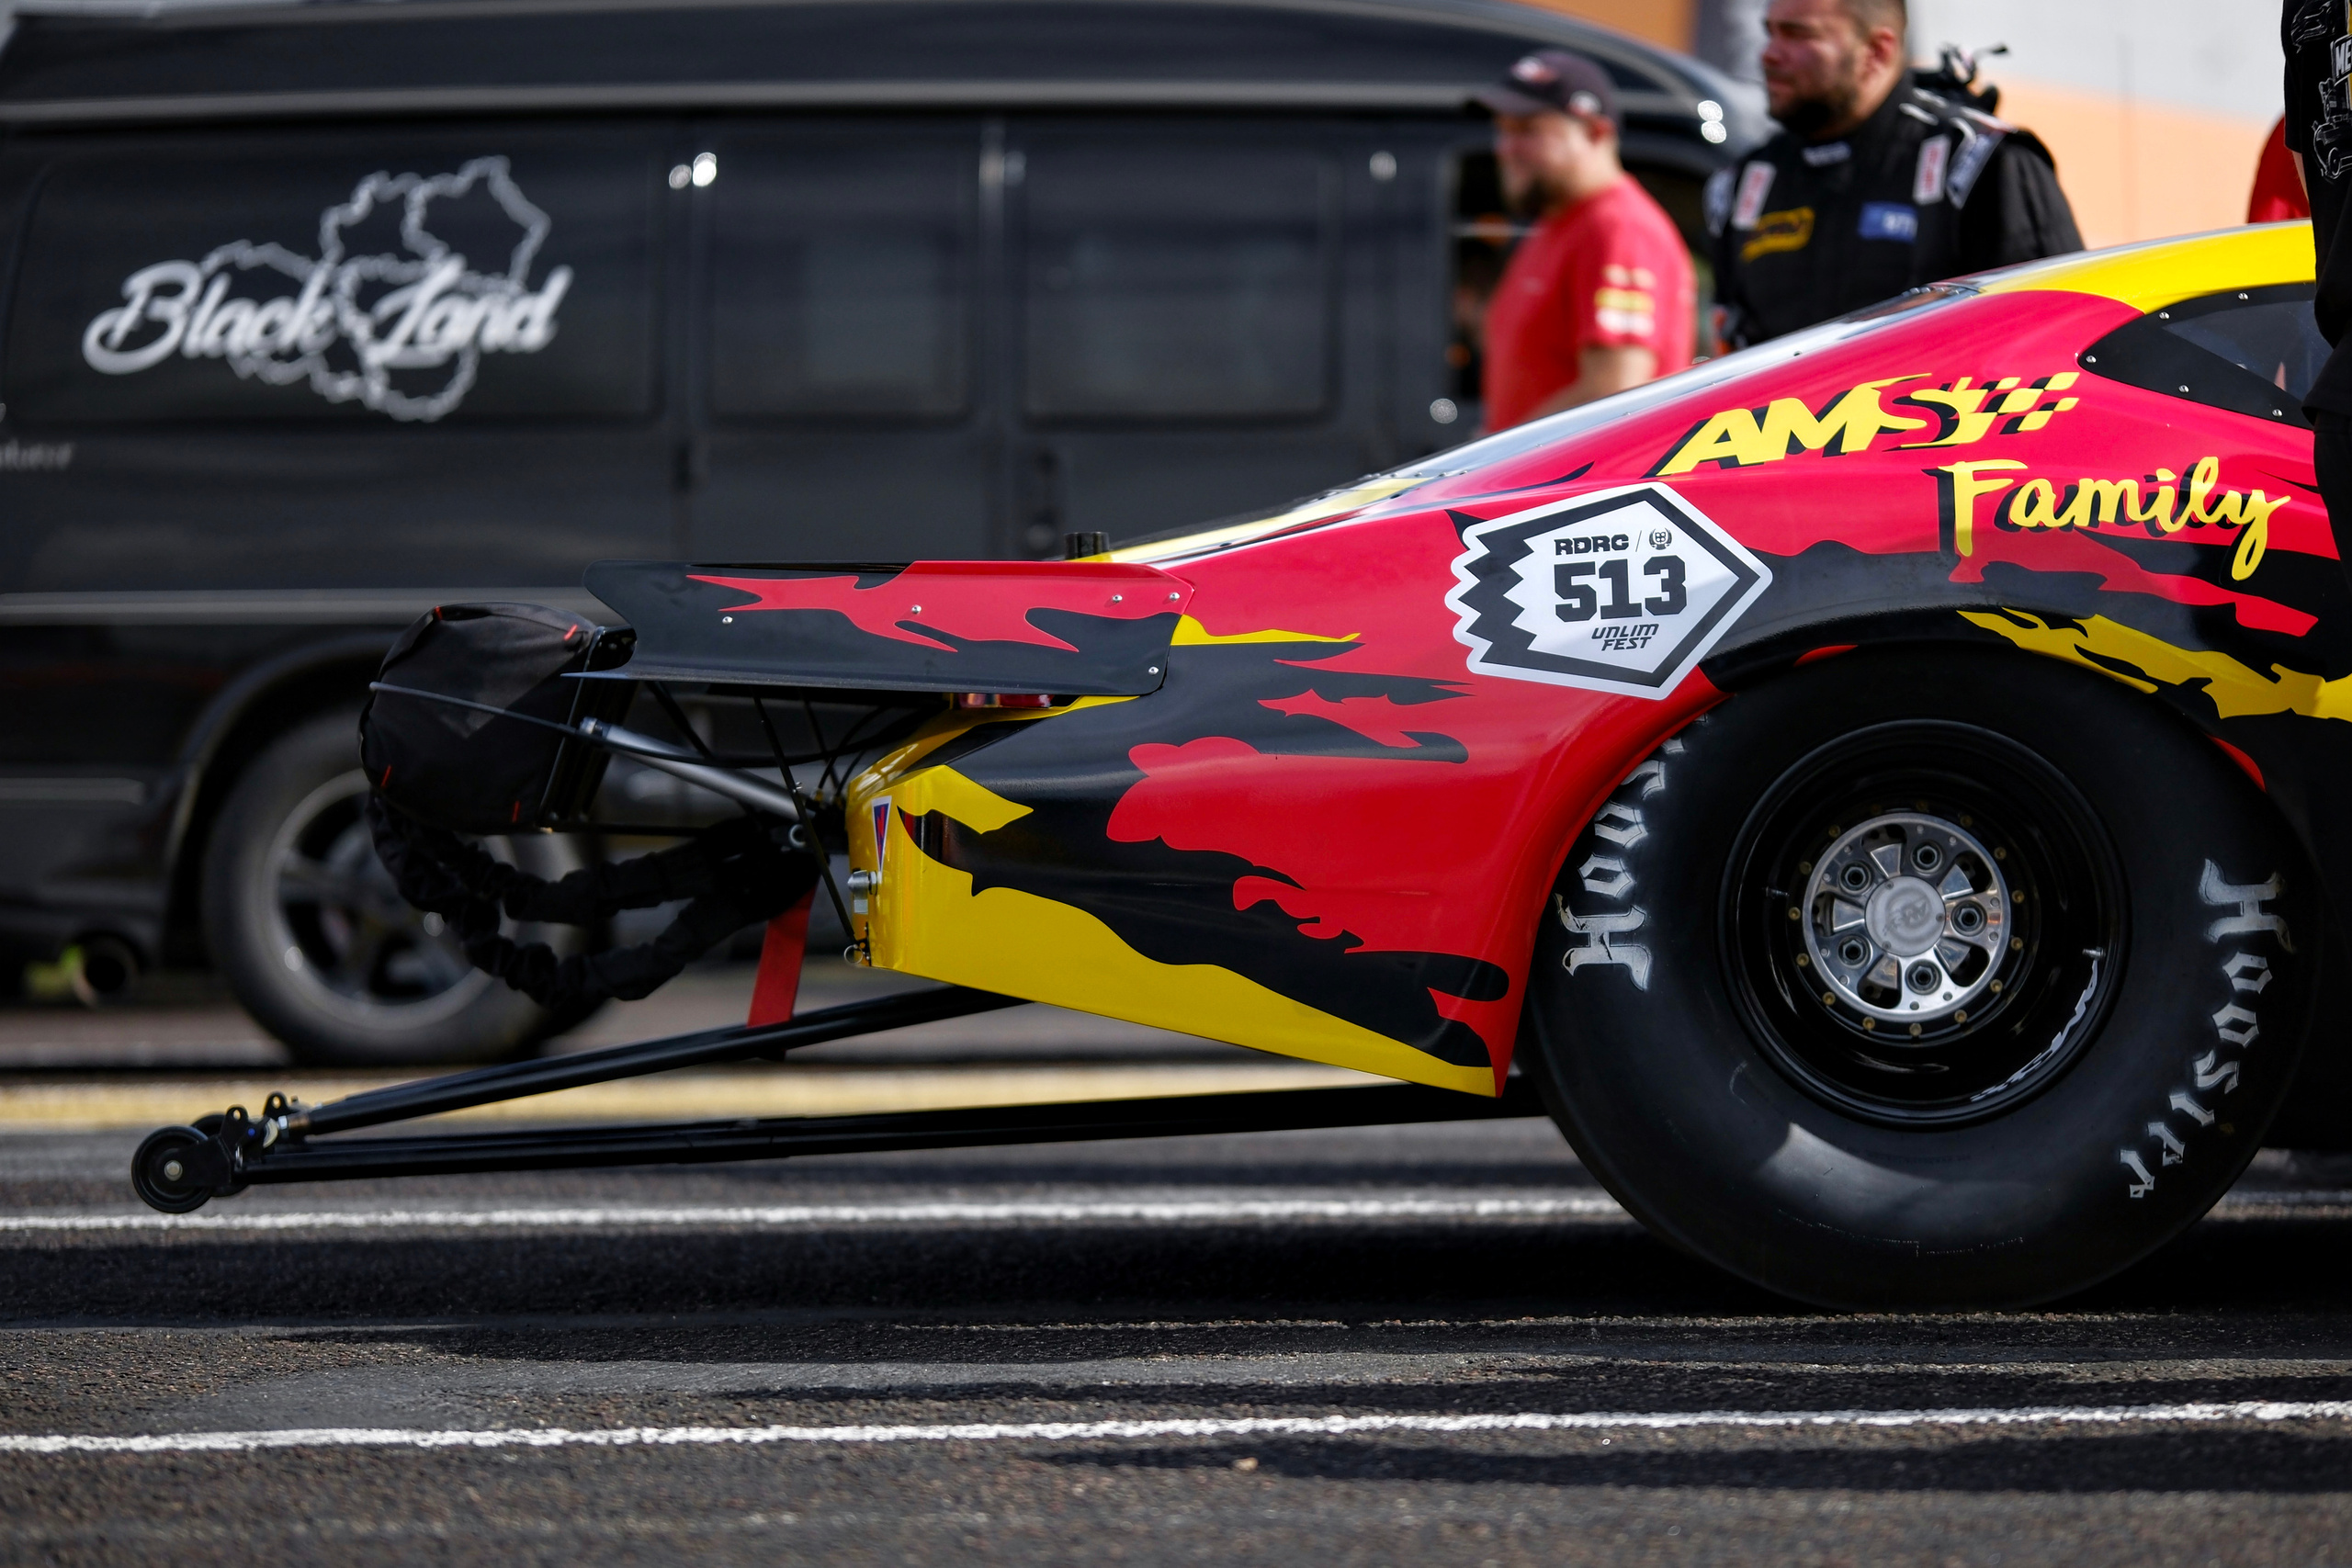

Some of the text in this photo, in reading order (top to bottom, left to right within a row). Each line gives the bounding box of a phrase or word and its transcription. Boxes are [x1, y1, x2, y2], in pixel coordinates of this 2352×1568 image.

[83, 260, 340, 374] Black
[1553, 533, 1630, 556] RDRC
[1935, 456, 2292, 581] Family
[1553, 554, 1688, 623] 513
[1600, 636, 1653, 651] FEST
[2118, 857, 2295, 1200] Hoosier
